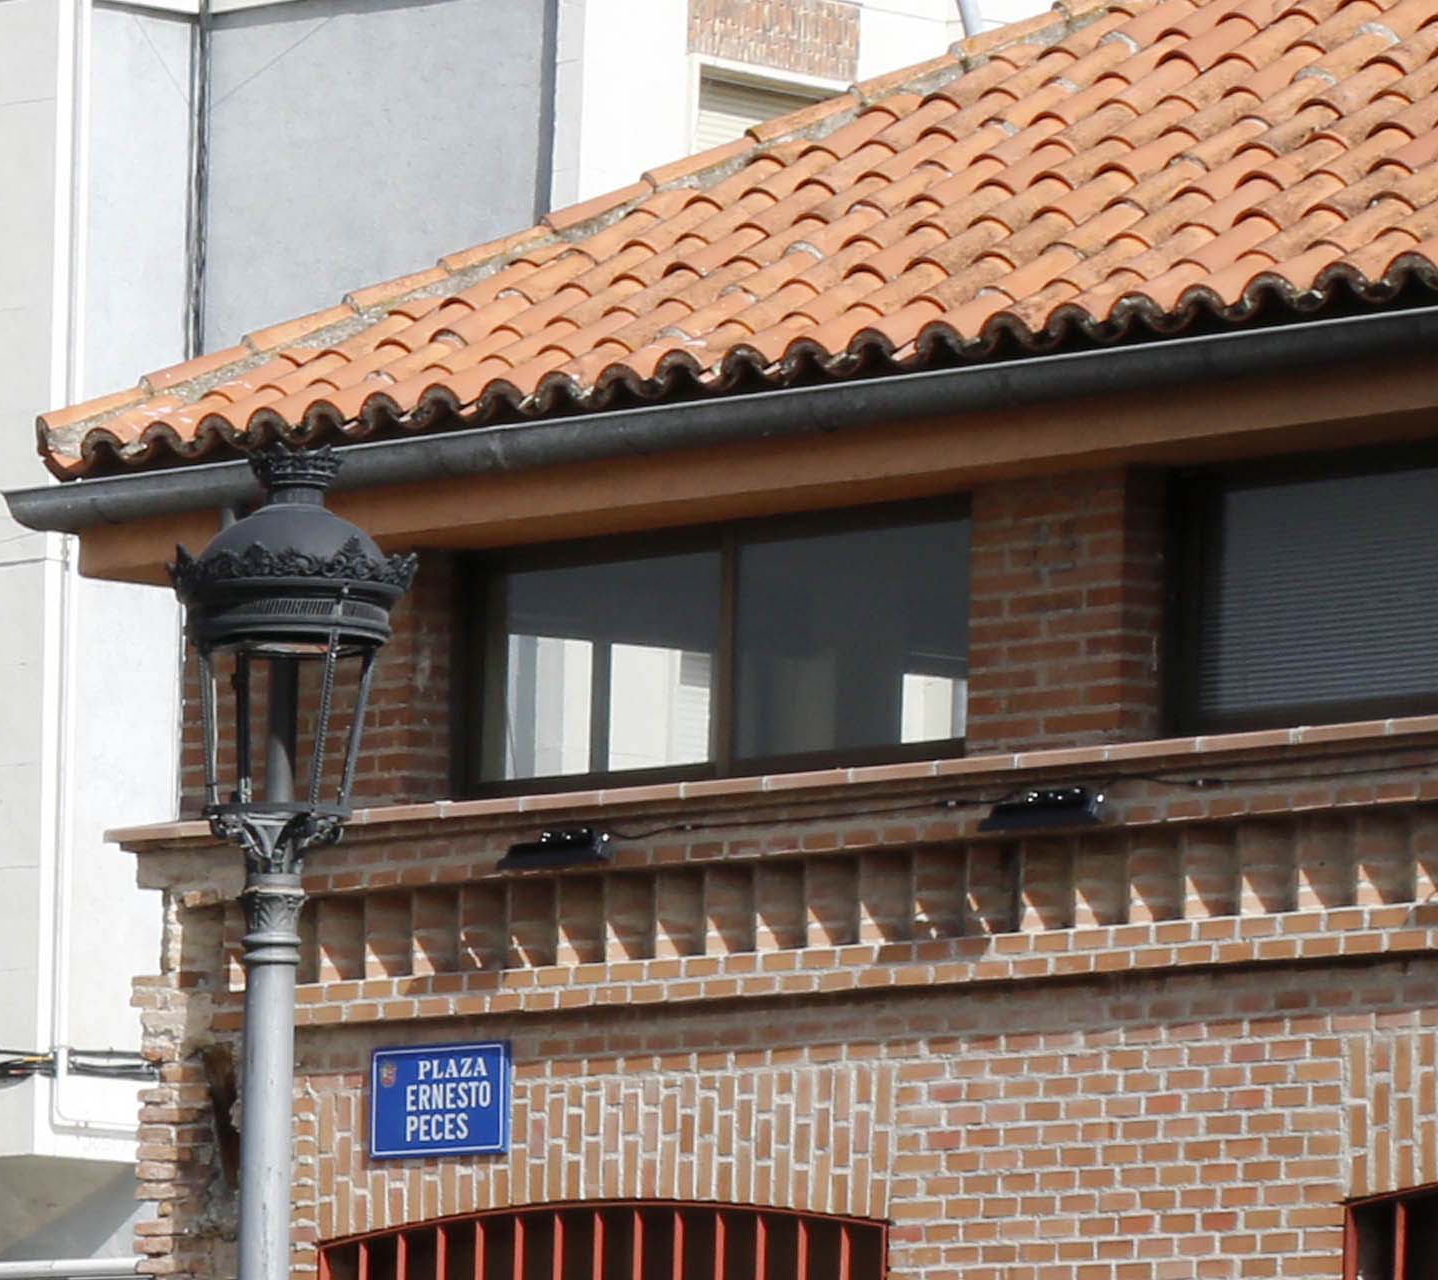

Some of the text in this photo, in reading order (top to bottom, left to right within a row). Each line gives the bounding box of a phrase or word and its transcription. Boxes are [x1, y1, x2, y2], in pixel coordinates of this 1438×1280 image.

[417, 1057, 488, 1080] PLAZA
[406, 1081, 491, 1112] ERNESTO
[406, 1113, 469, 1142] PECES
